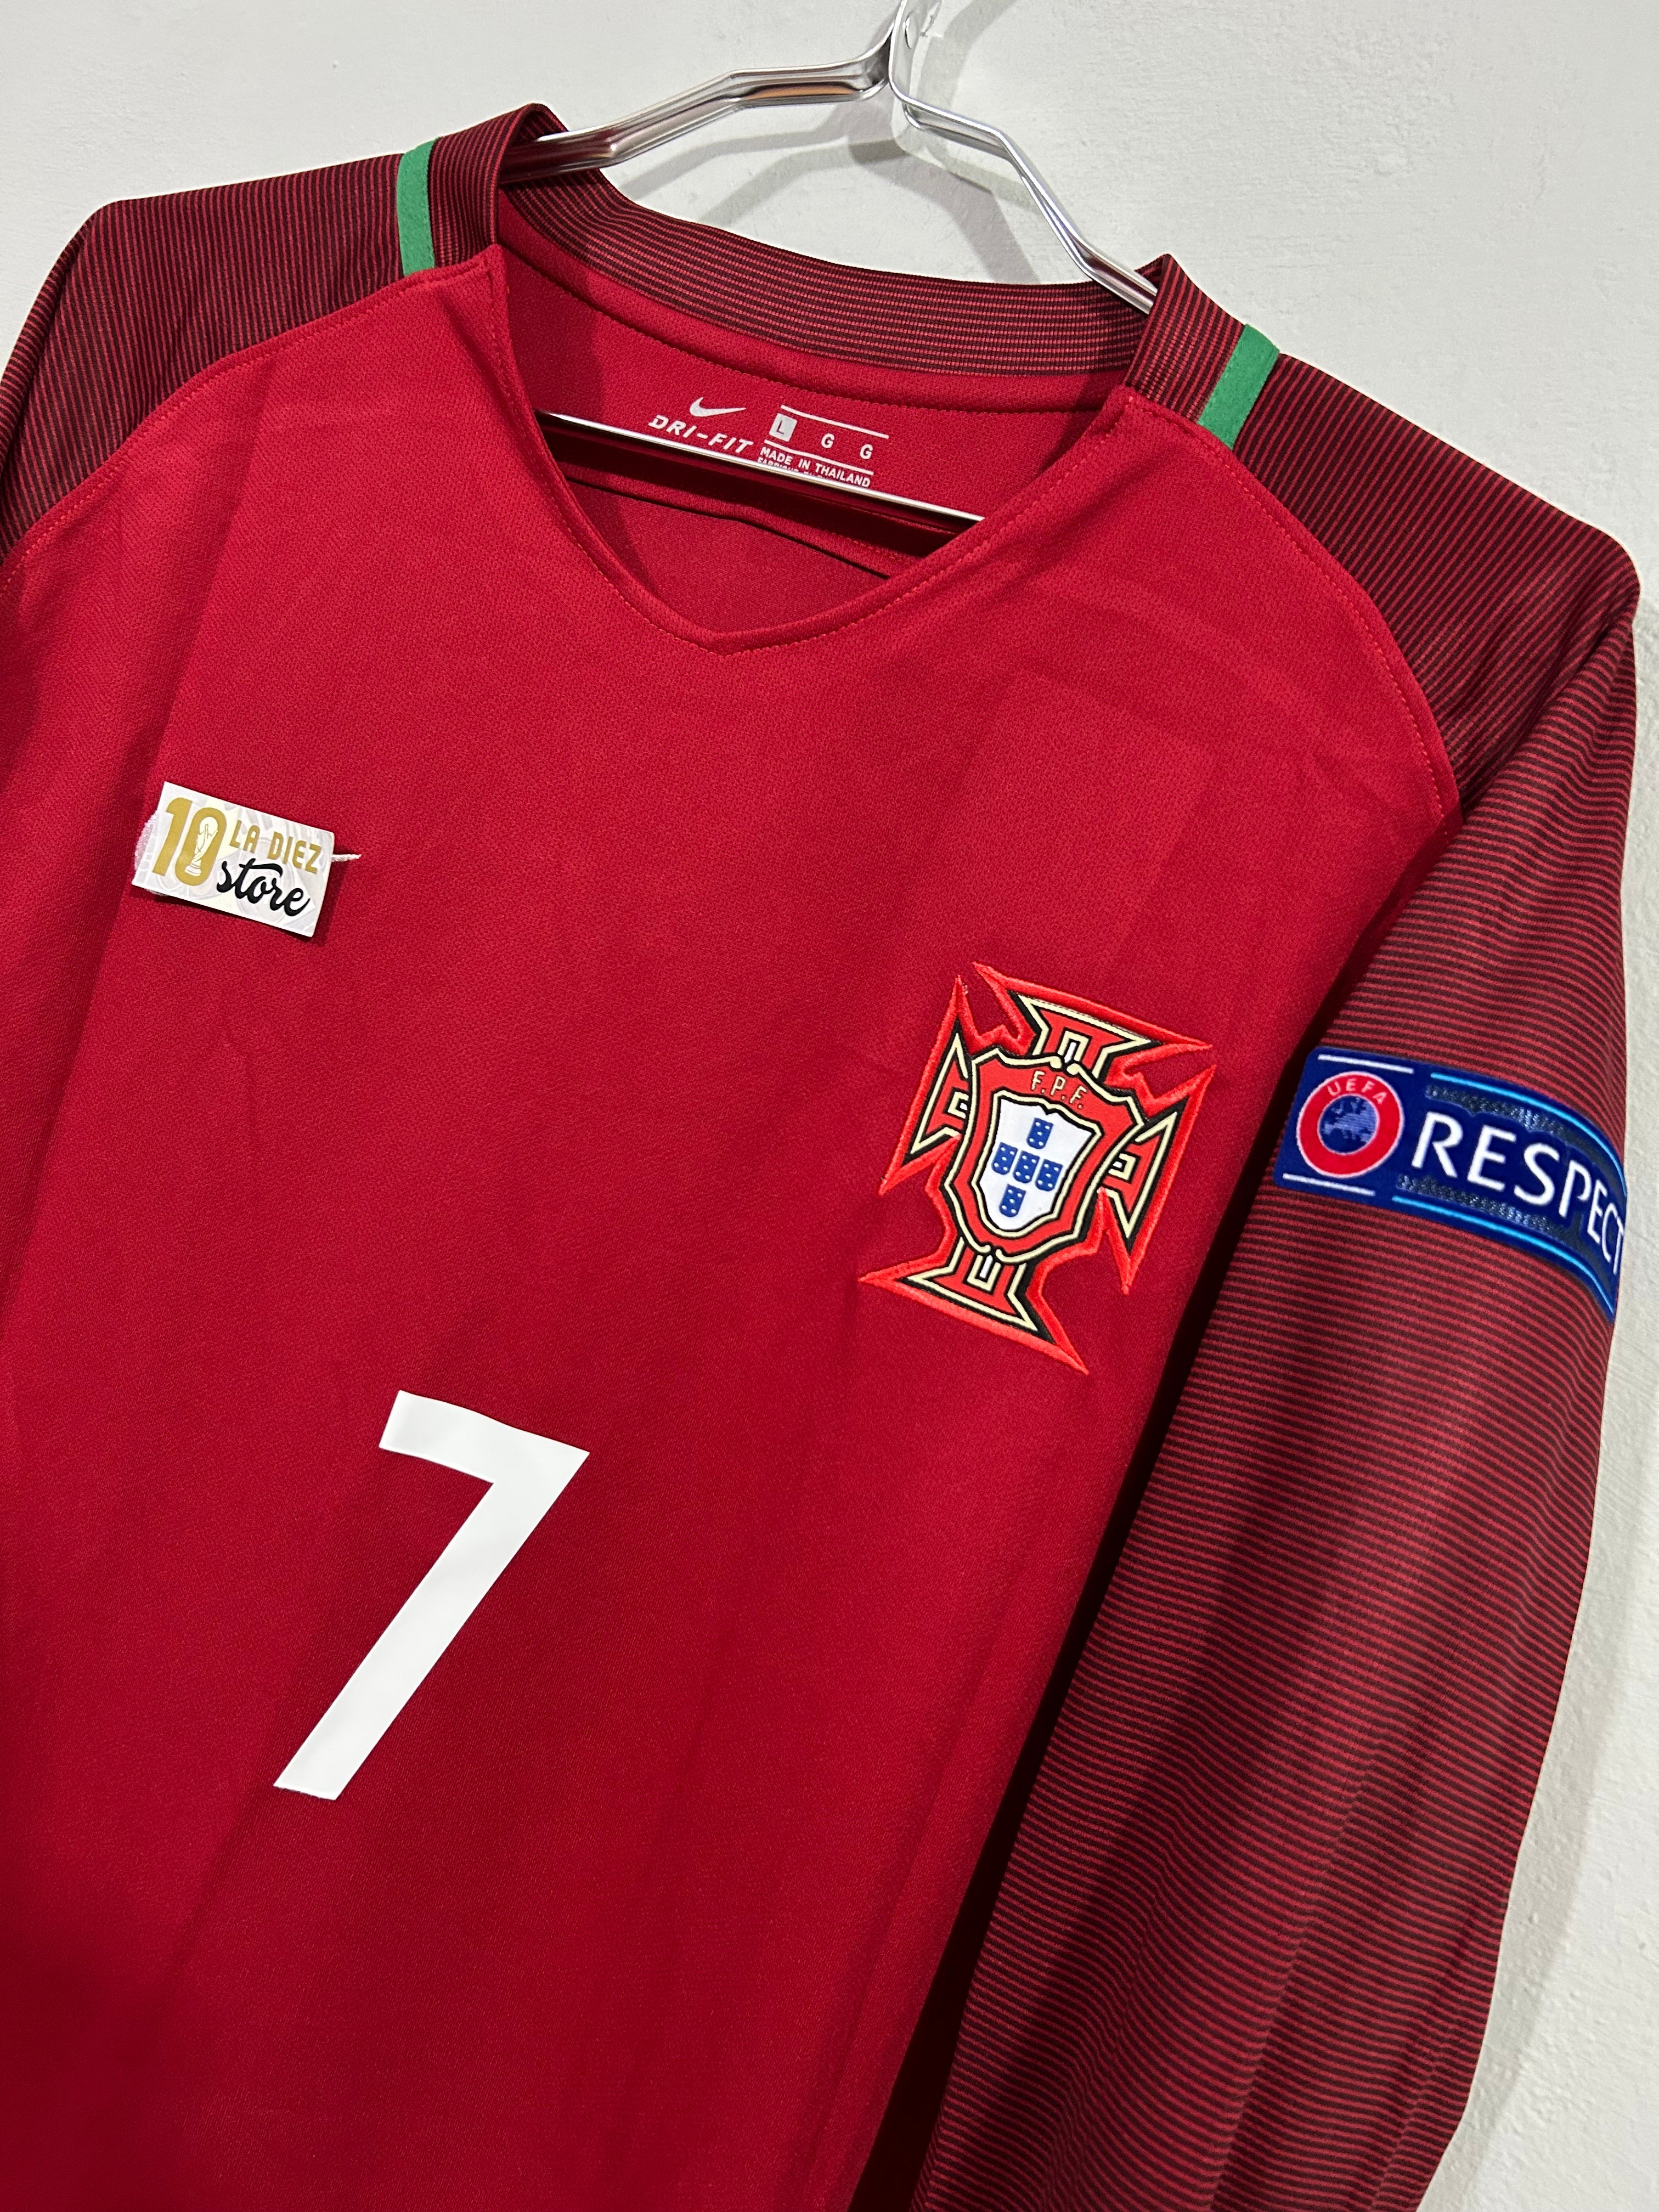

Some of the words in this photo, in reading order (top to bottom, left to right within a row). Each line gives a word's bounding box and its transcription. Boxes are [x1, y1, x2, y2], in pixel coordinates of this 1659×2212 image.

[648, 415, 754, 454] DRI-FIT
[821, 433, 834, 449] G
[860, 444, 873, 460] G
[760, 447, 793, 465] MADE
[798, 459, 811, 470] IN
[815, 462, 871, 488] THAILAND
[153, 797, 227, 887] 10
[229, 820, 261, 854] LA
[267, 831, 323, 874] DIEZ
[216, 858, 311, 917] store
[1327, 1078, 1387, 1105] UEFA
[1411, 1111, 1624, 1275] RESPECT
[273, 1390, 590, 1801] 7
